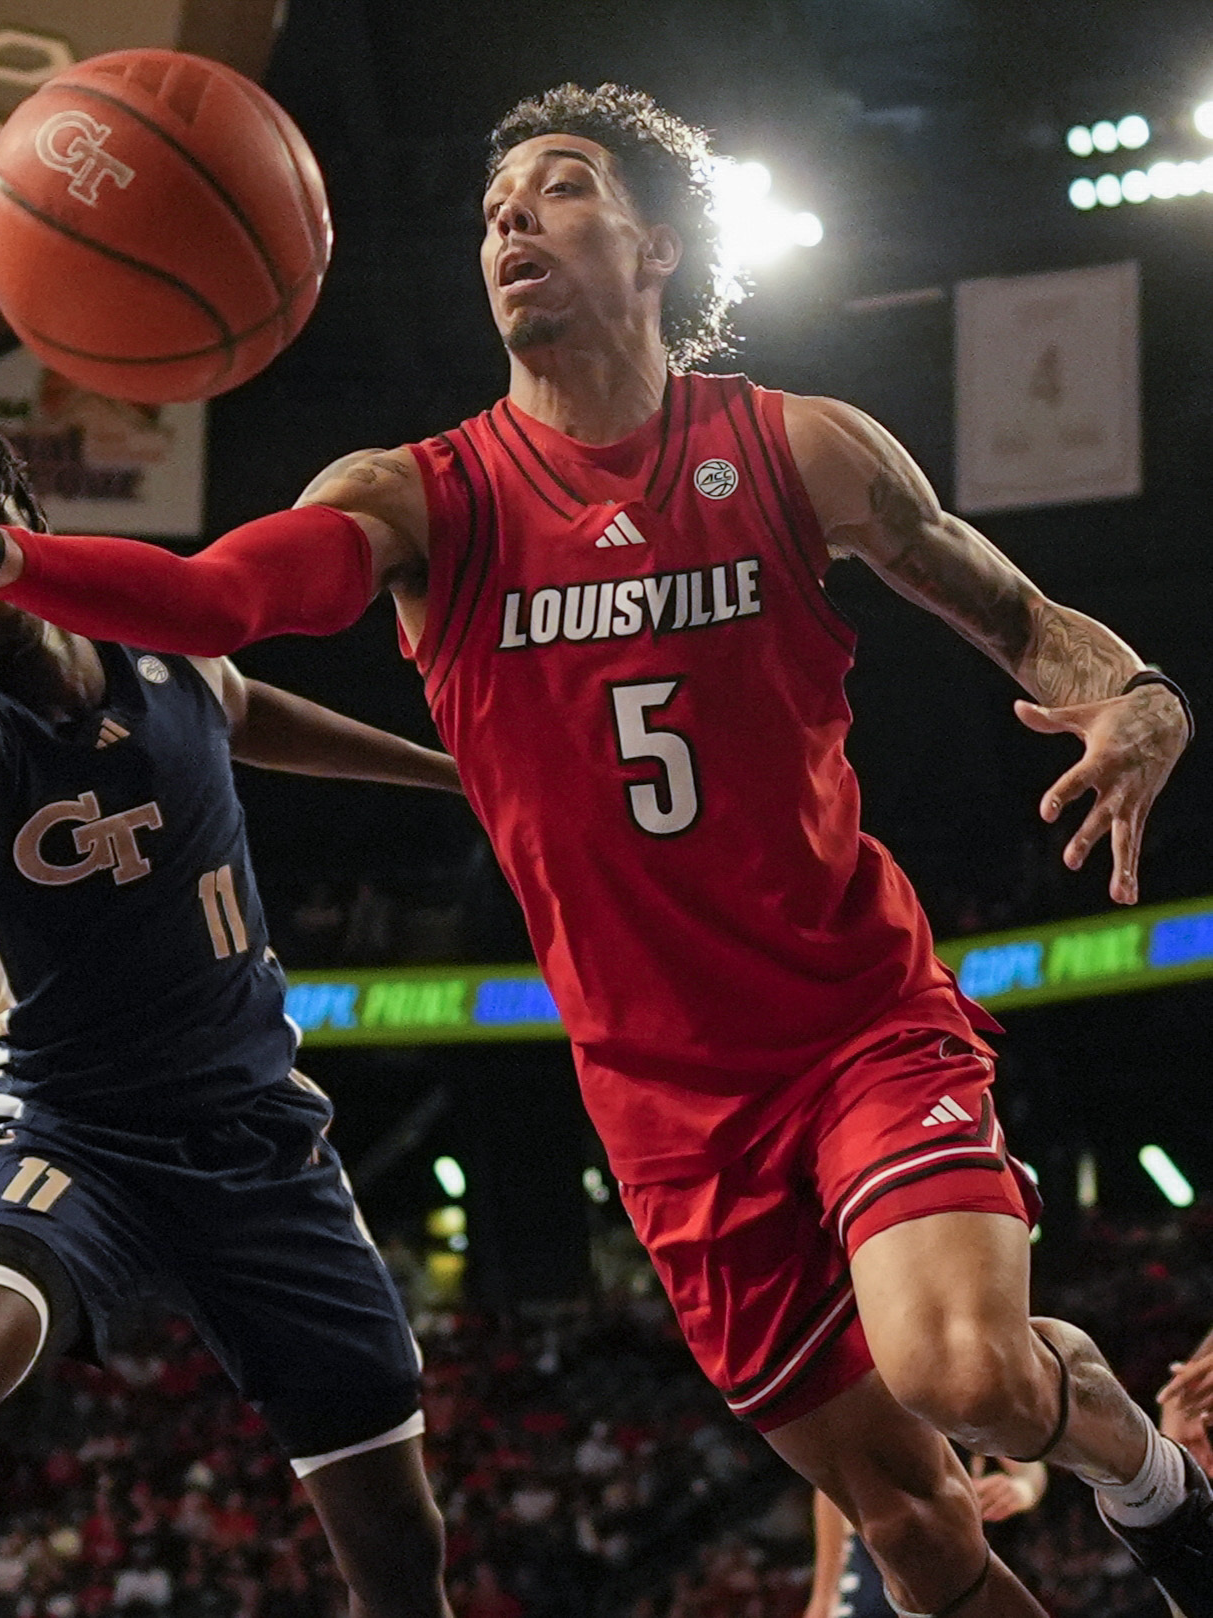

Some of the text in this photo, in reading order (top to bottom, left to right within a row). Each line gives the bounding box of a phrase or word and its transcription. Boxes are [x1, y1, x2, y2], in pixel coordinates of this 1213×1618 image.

[35, 110, 136, 208] GT
[698, 469, 734, 486] ACC
[498, 558, 762, 650] LOUISVILLE
[608, 677, 702, 839] 5
[13, 790, 163, 886] GT
[198, 864, 248, 960] 11
[1, 1156, 73, 1213] 11
